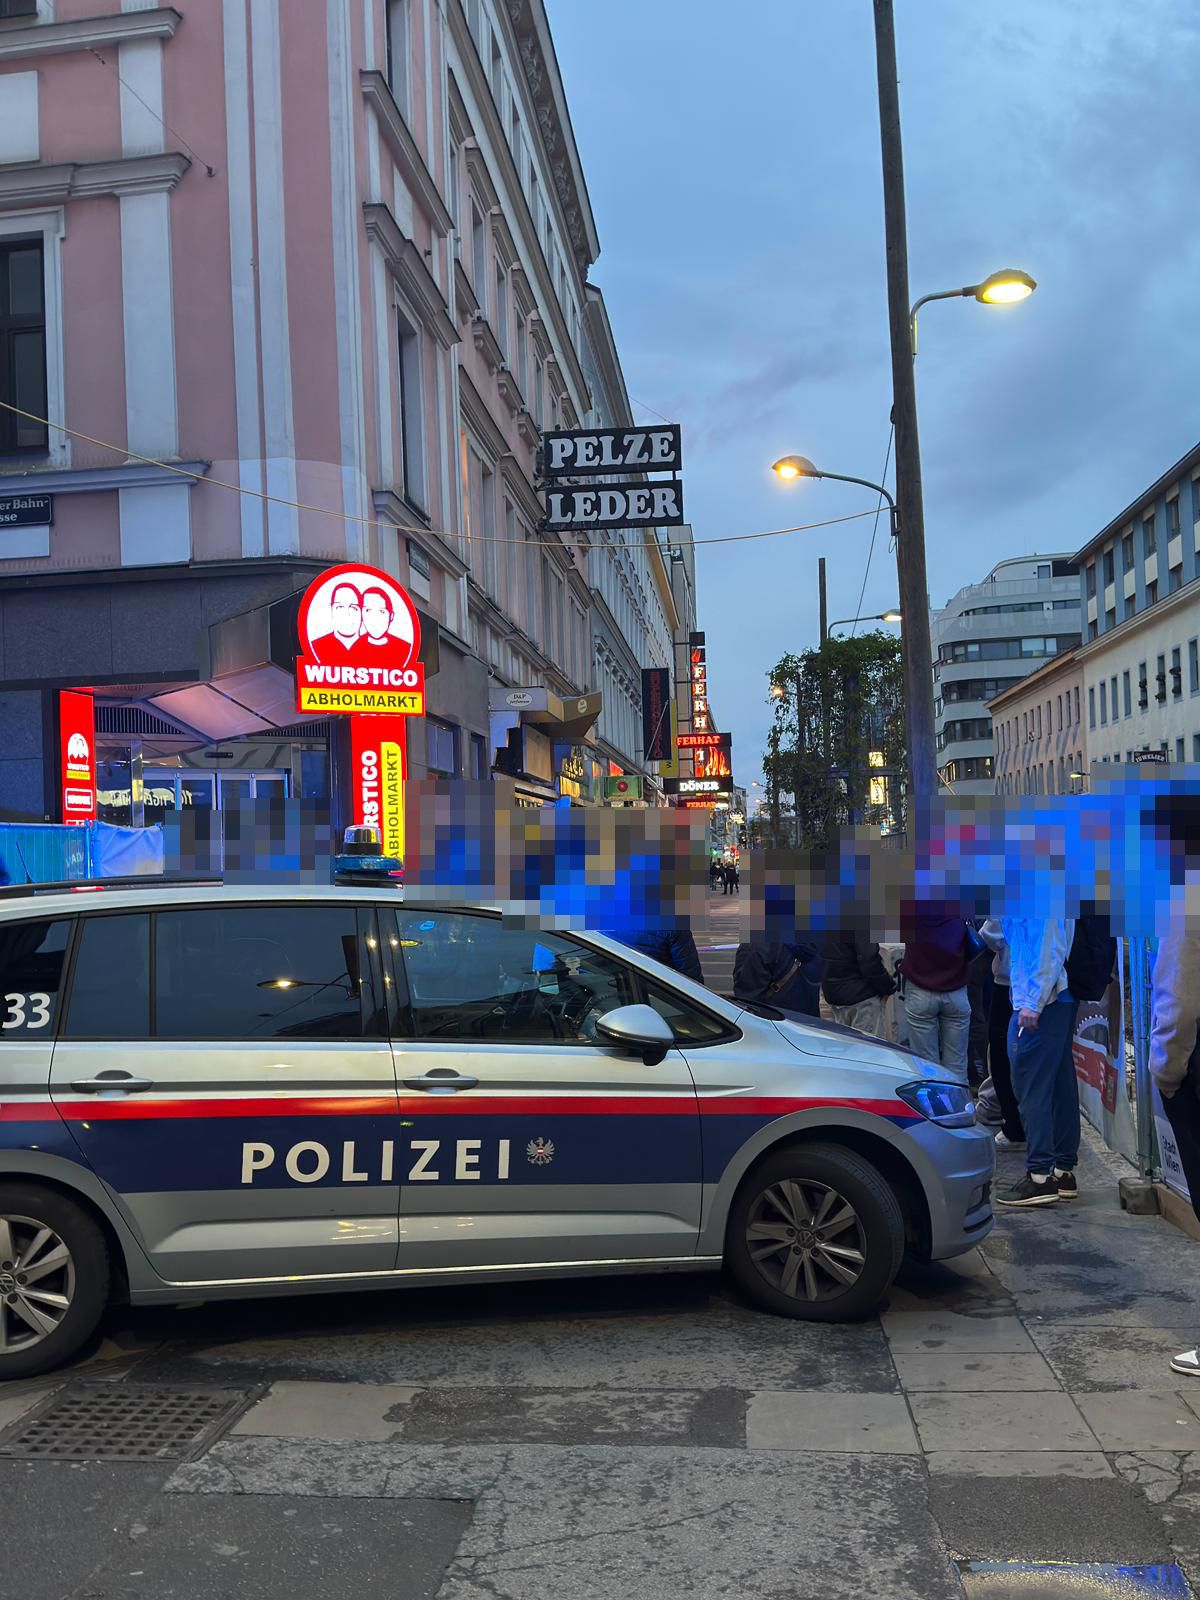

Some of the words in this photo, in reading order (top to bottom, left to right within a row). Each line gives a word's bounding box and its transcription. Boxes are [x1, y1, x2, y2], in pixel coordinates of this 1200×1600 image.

[549, 431, 675, 468] PELZE
[12, 498, 48, 509] Bahn-
[549, 488, 680, 523] LEDER
[304, 664, 418, 687] WURSTICO
[307, 693, 418, 708] ABHOLMARKT
[677, 736, 720, 745] FERHAT
[679, 780, 720, 791] DÖNER
[2, 992, 50, 1029] 33
[241, 1139, 510, 1184] POLIZEI
[1163, 1151, 1180, 1174] Wien
